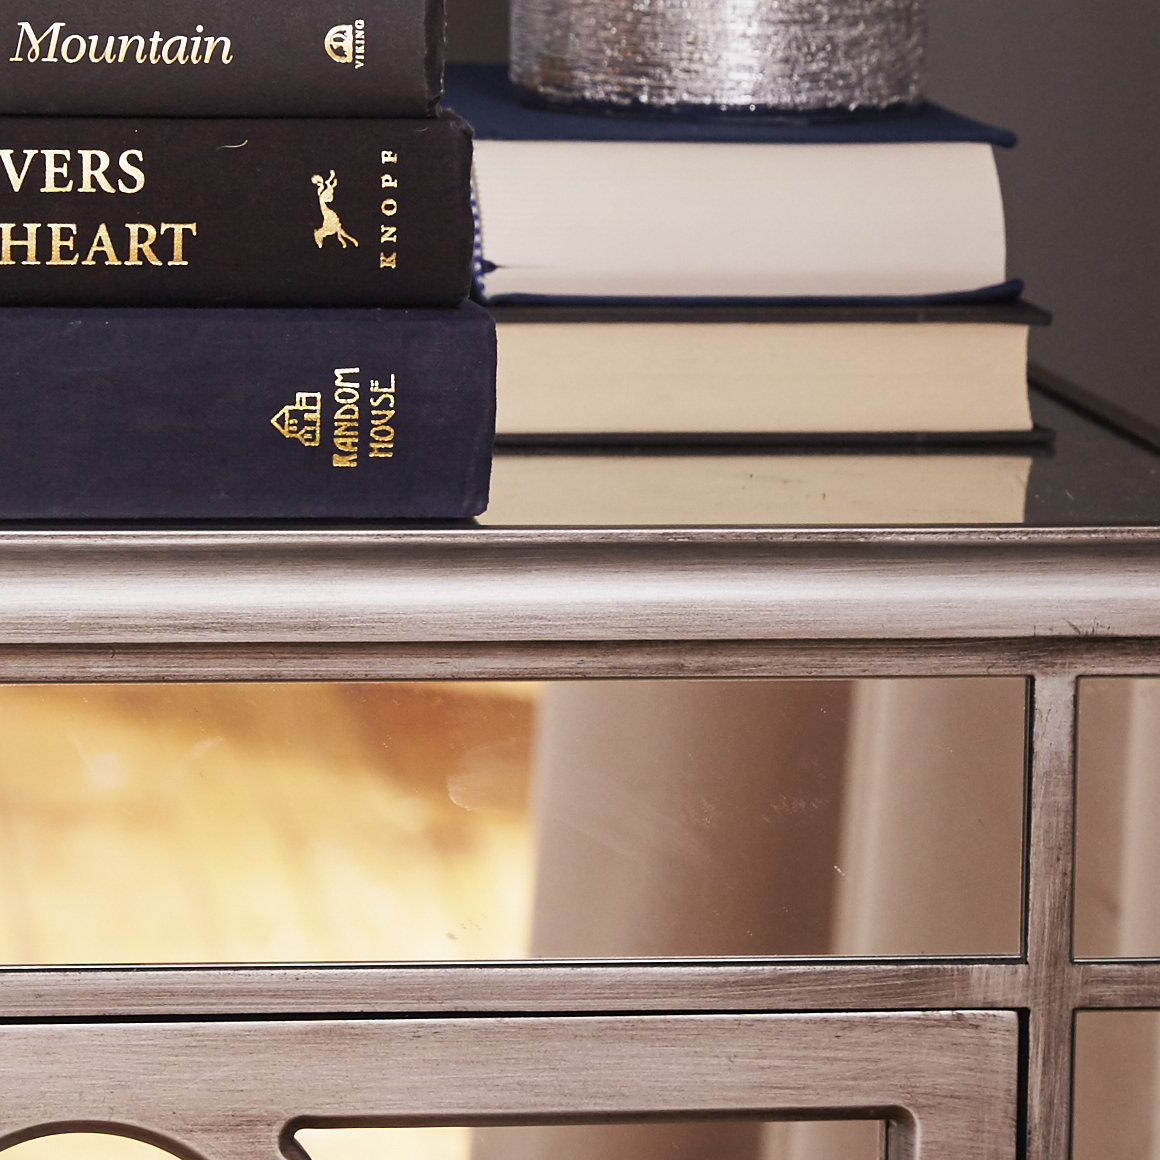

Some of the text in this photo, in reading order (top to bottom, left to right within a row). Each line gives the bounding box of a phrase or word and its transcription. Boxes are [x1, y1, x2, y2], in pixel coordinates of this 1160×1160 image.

[8, 21, 234, 65] Mountain
[354, 19, 366, 70] VIKING
[379, 150, 398, 269] KNOPF
[332, 367, 361, 468] RANDOM
[368, 373, 396, 458] HOUSE
